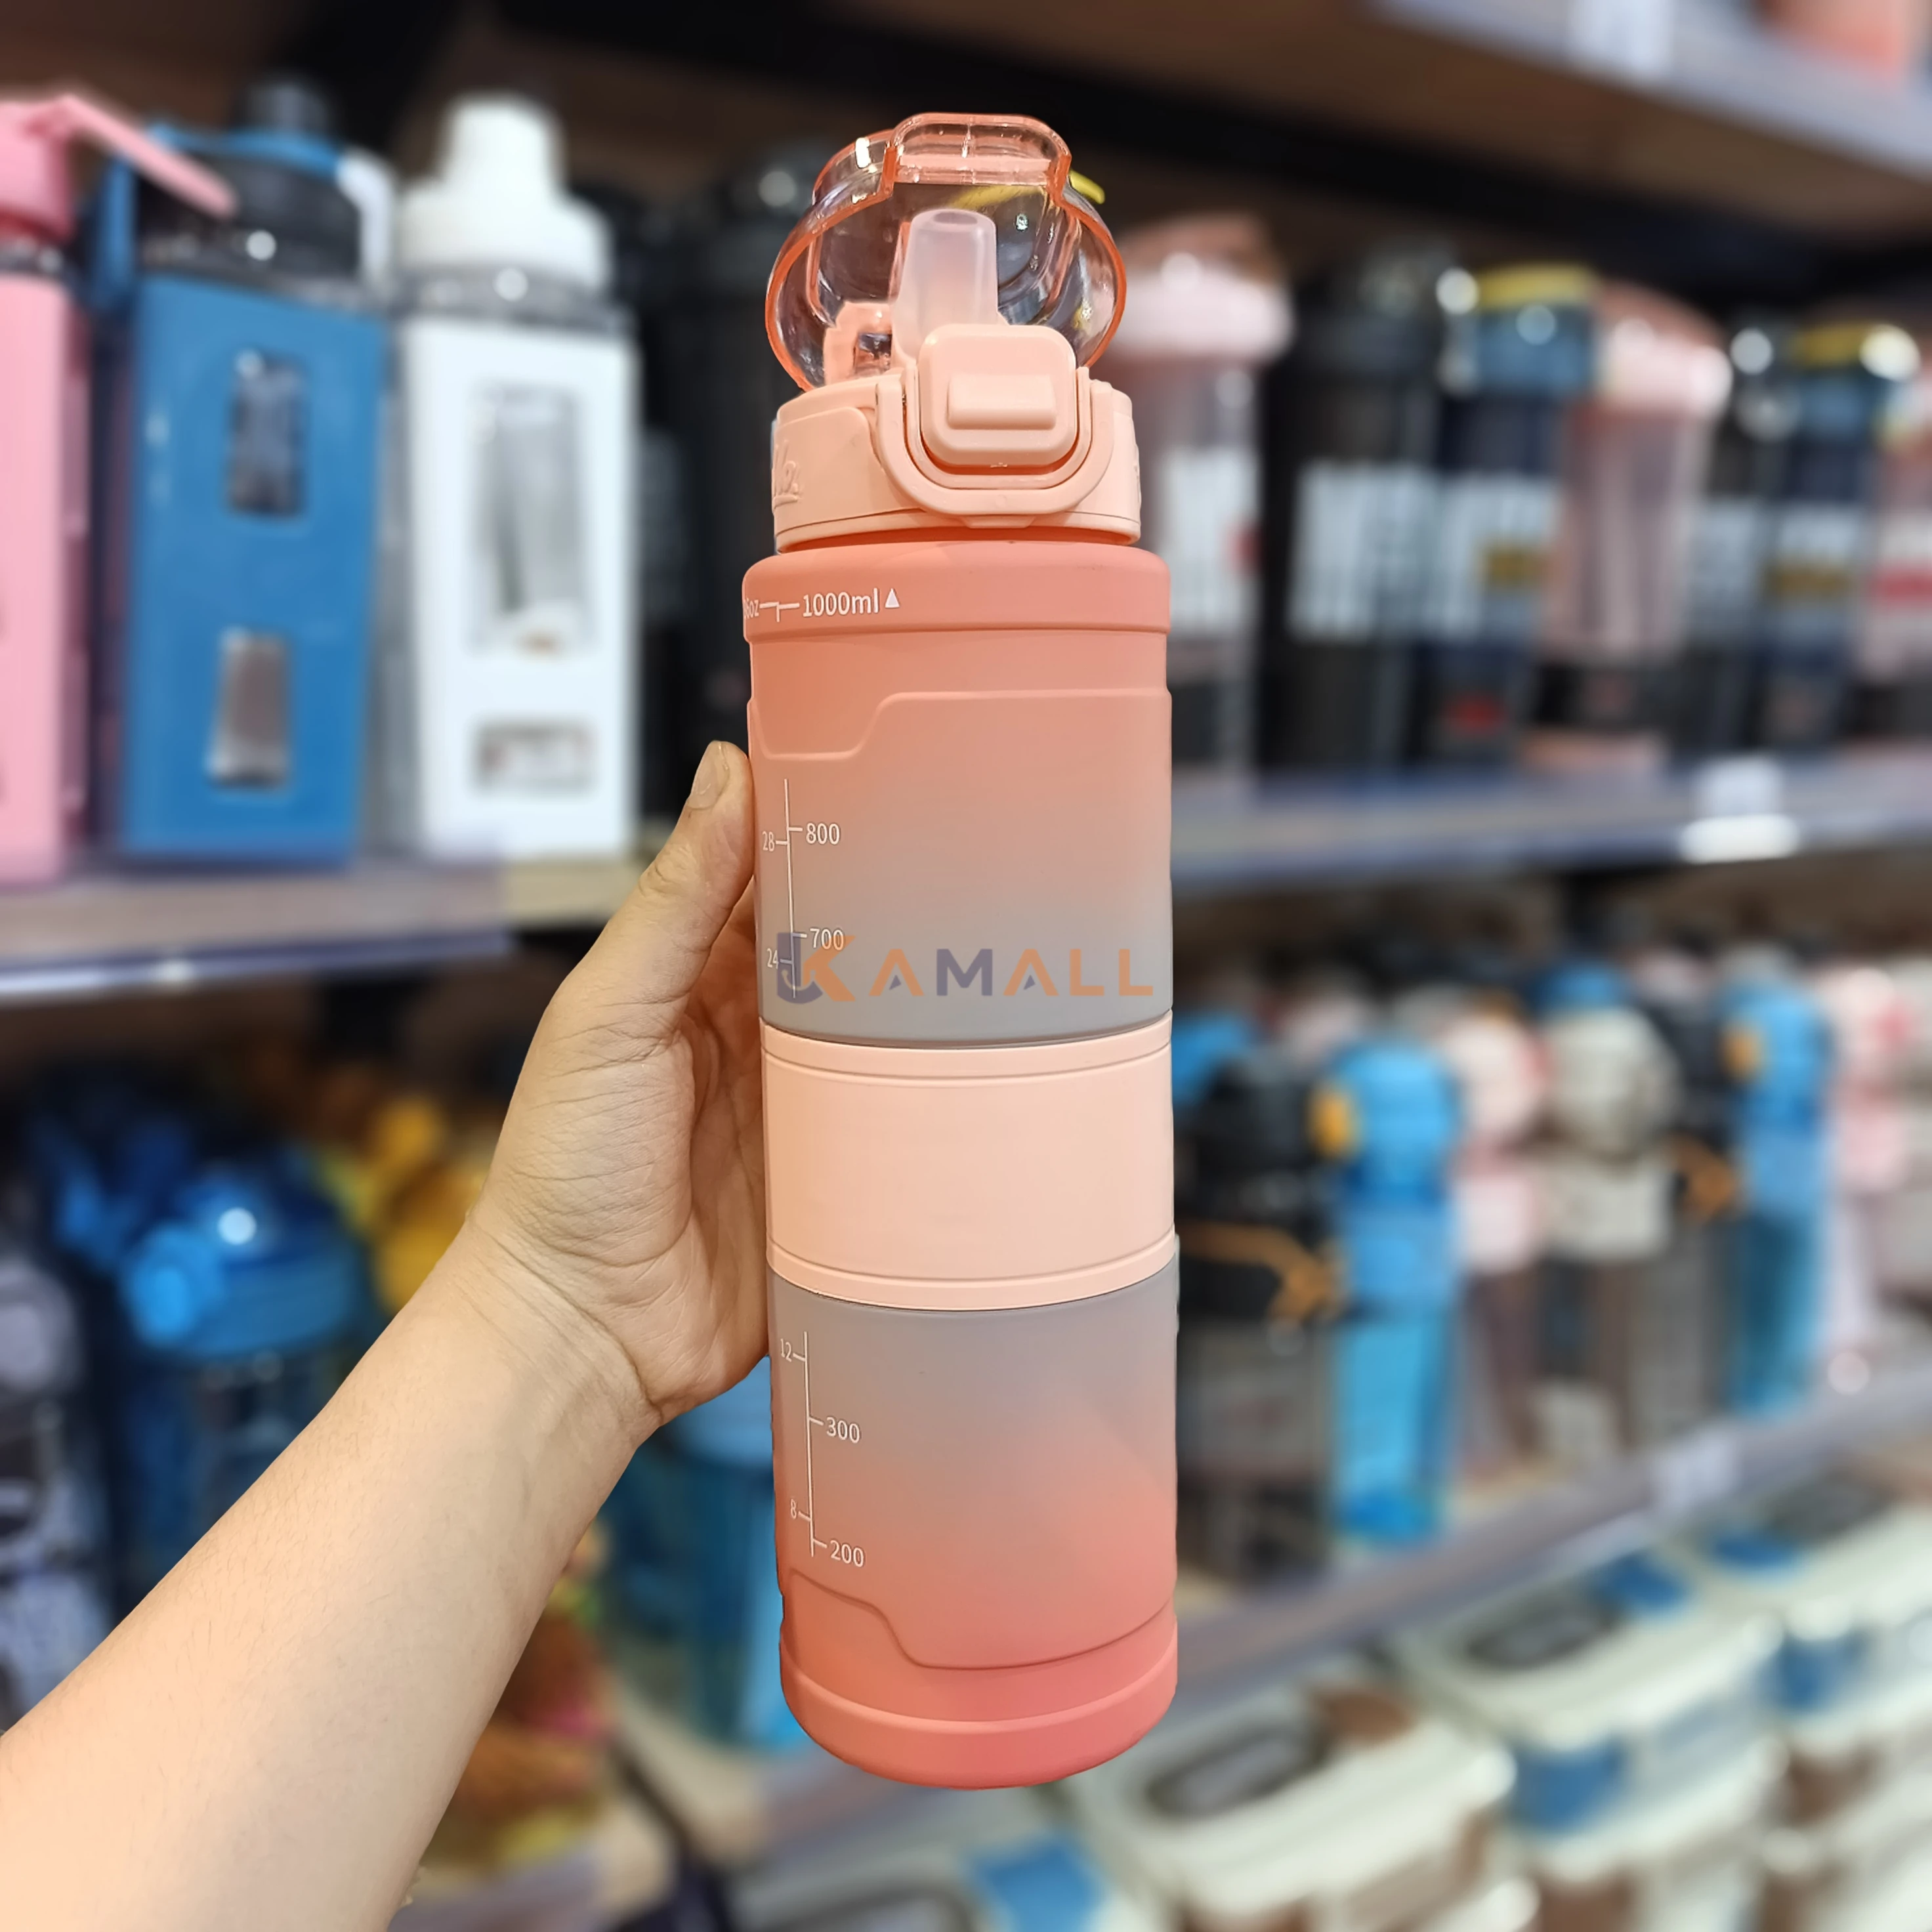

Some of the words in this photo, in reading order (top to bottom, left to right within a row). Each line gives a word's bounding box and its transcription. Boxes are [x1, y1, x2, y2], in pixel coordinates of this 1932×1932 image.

[803, 587, 879, 617] 1000ml
[762, 831, 775, 852] 28
[806, 822, 840, 845] 800
[810, 928, 844, 950] 700
[766, 948, 779, 969] 24
[780, 1338, 792, 1362] 12
[826, 1417, 861, 1444] 300
[789, 1498, 797, 1519] 8
[830, 1540, 865, 1568] 200
